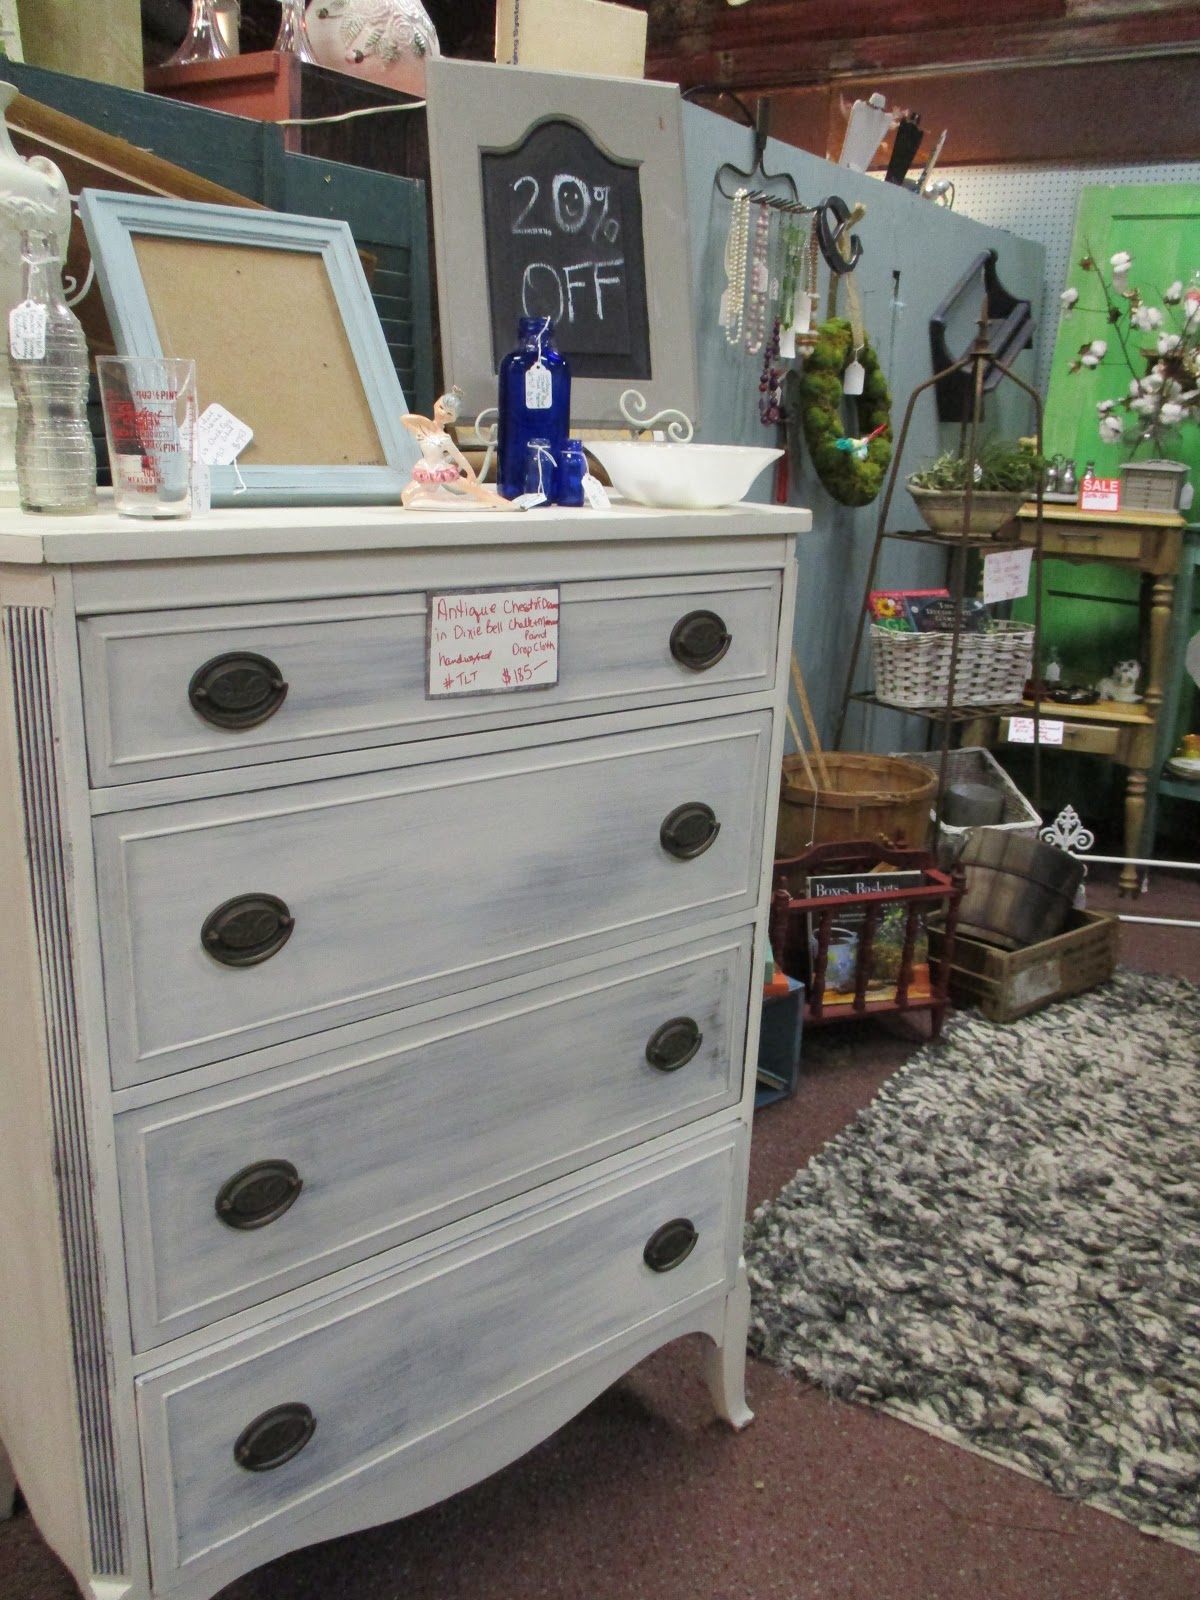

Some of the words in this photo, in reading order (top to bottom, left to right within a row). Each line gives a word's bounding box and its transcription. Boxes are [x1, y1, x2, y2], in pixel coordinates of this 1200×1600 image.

[511, 174, 619, 243] 20%
[522, 258, 624, 324] OFF
[1083, 480, 1118, 492] SALE
[437, 598, 497, 623] Antique
[454, 624, 482, 640] Dixie
[486, 619, 503, 634] Bell
[512, 642, 532, 657] Drop
